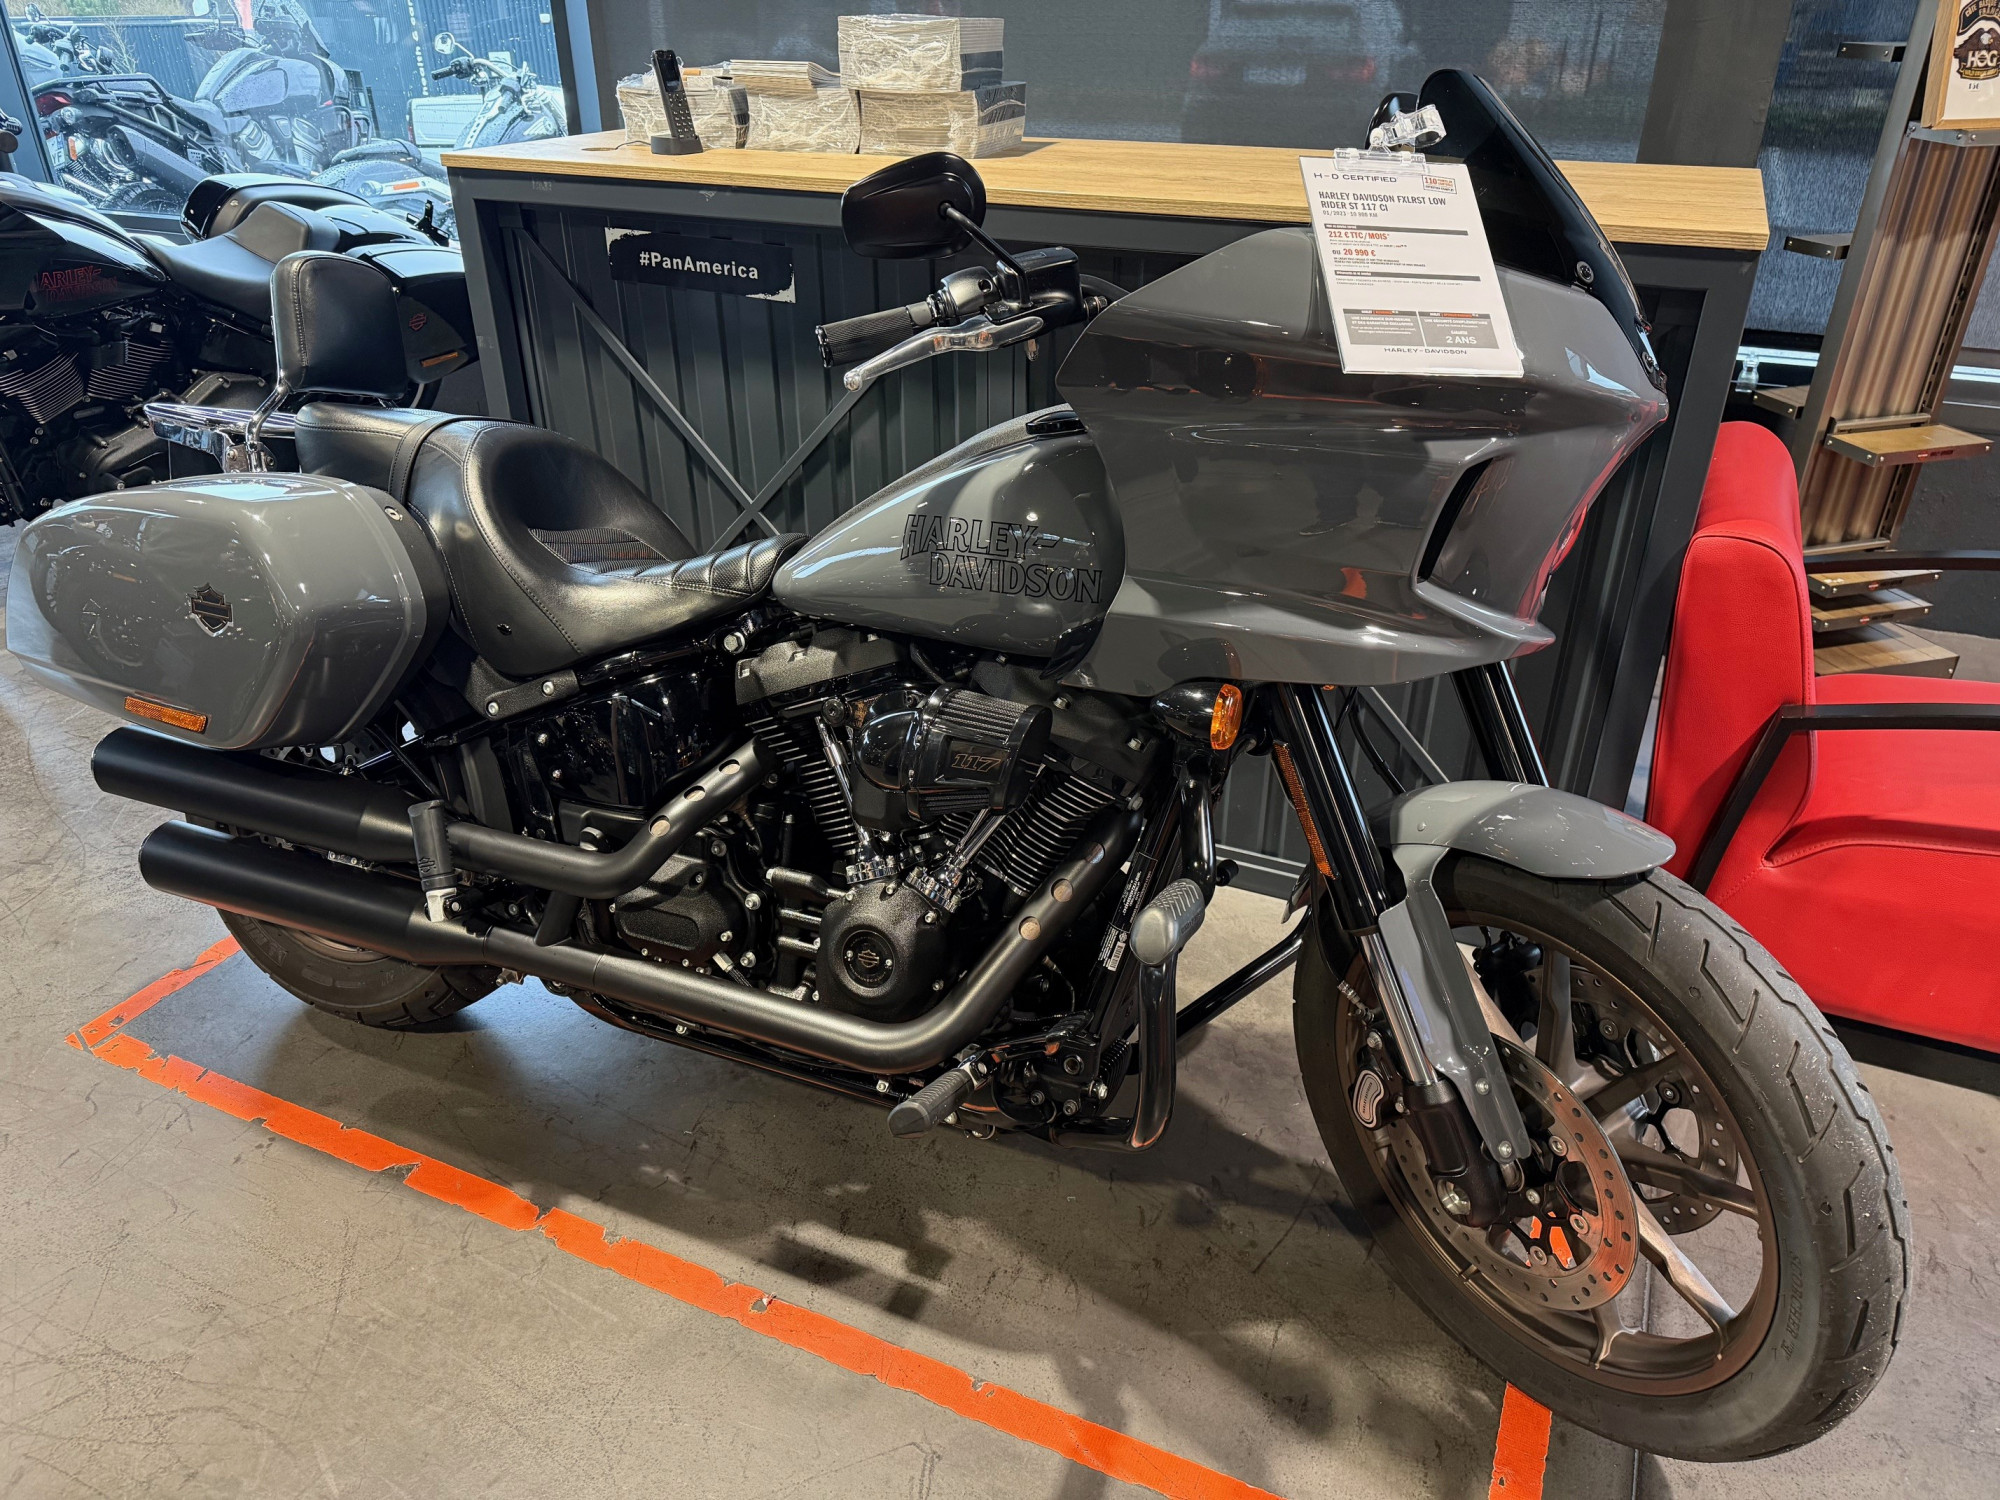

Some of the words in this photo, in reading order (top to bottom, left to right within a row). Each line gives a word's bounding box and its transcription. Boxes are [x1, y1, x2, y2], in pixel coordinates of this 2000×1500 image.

[1966, 50, 1998, 68] HOG
[1342, 174, 1397, 183] CERTIFIED
[1424, 177, 1438, 185] 110
[1318, 191, 1350, 201] HARLEY
[1353, 194, 1395, 203] DAVIDSON
[1397, 195, 1426, 205] FXLRST
[1428, 197, 1446, 206] LOW
[1321, 201, 1347, 210] RIDER
[1349, 202, 1358, 210] ST
[1361, 202, 1376, 211] 117
[1379, 203, 1389, 212] CI
[1328, 230, 1343, 238] 212
[1344, 231, 1350, 239] €
[1343, 248, 1353, 256] 20
[1355, 249, 1369, 257] 990
[639, 250, 759, 280] #PanAmerica
[1446, 335, 1454, 344] 2
[1455, 336, 1477, 344] ANS
[929, 551, 1103, 604] DAVIDSON
[951, 753, 1002, 773] 117
